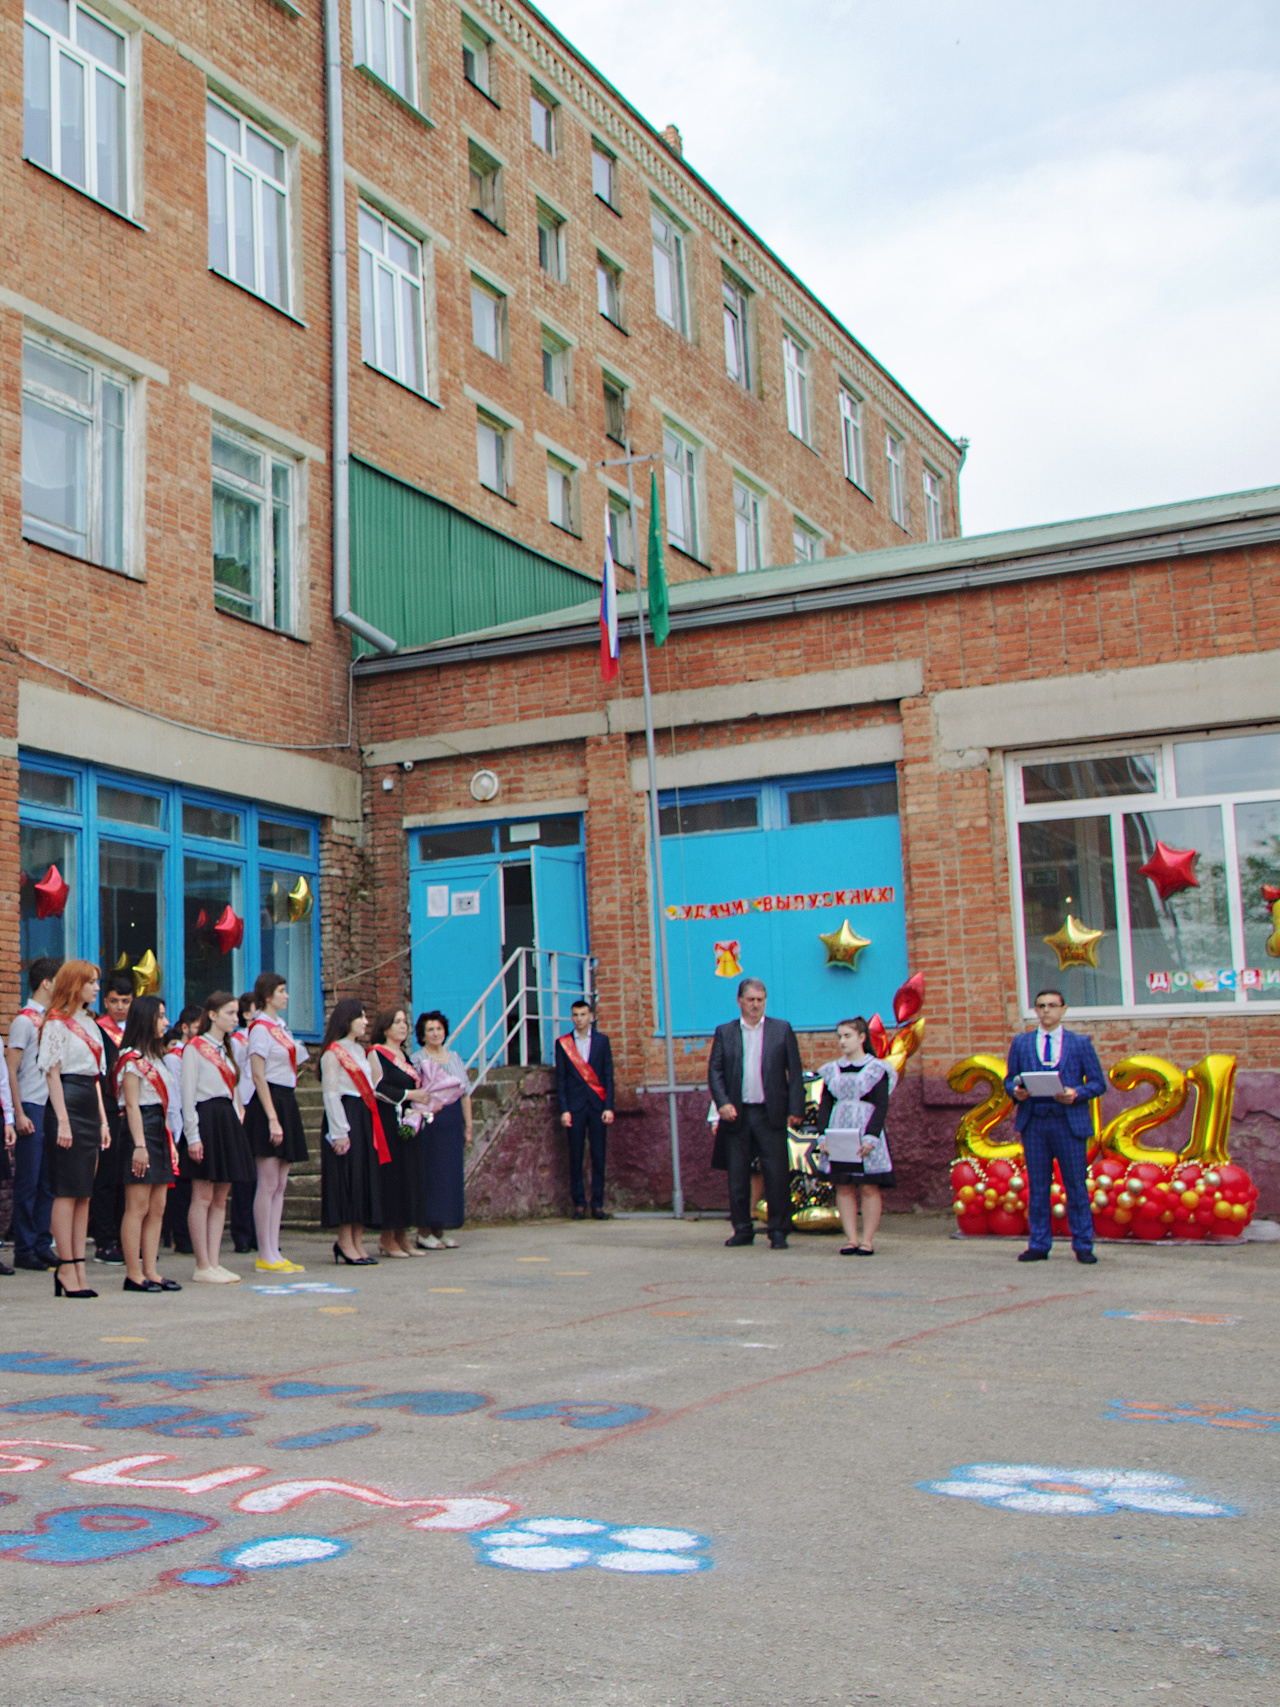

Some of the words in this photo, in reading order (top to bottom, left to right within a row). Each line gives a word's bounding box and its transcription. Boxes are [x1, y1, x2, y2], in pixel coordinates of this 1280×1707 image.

[682, 899, 745, 919] УДАЧИ
[1151, 971, 1189, 990] ДО
[946, 1054, 1236, 1163] 221
